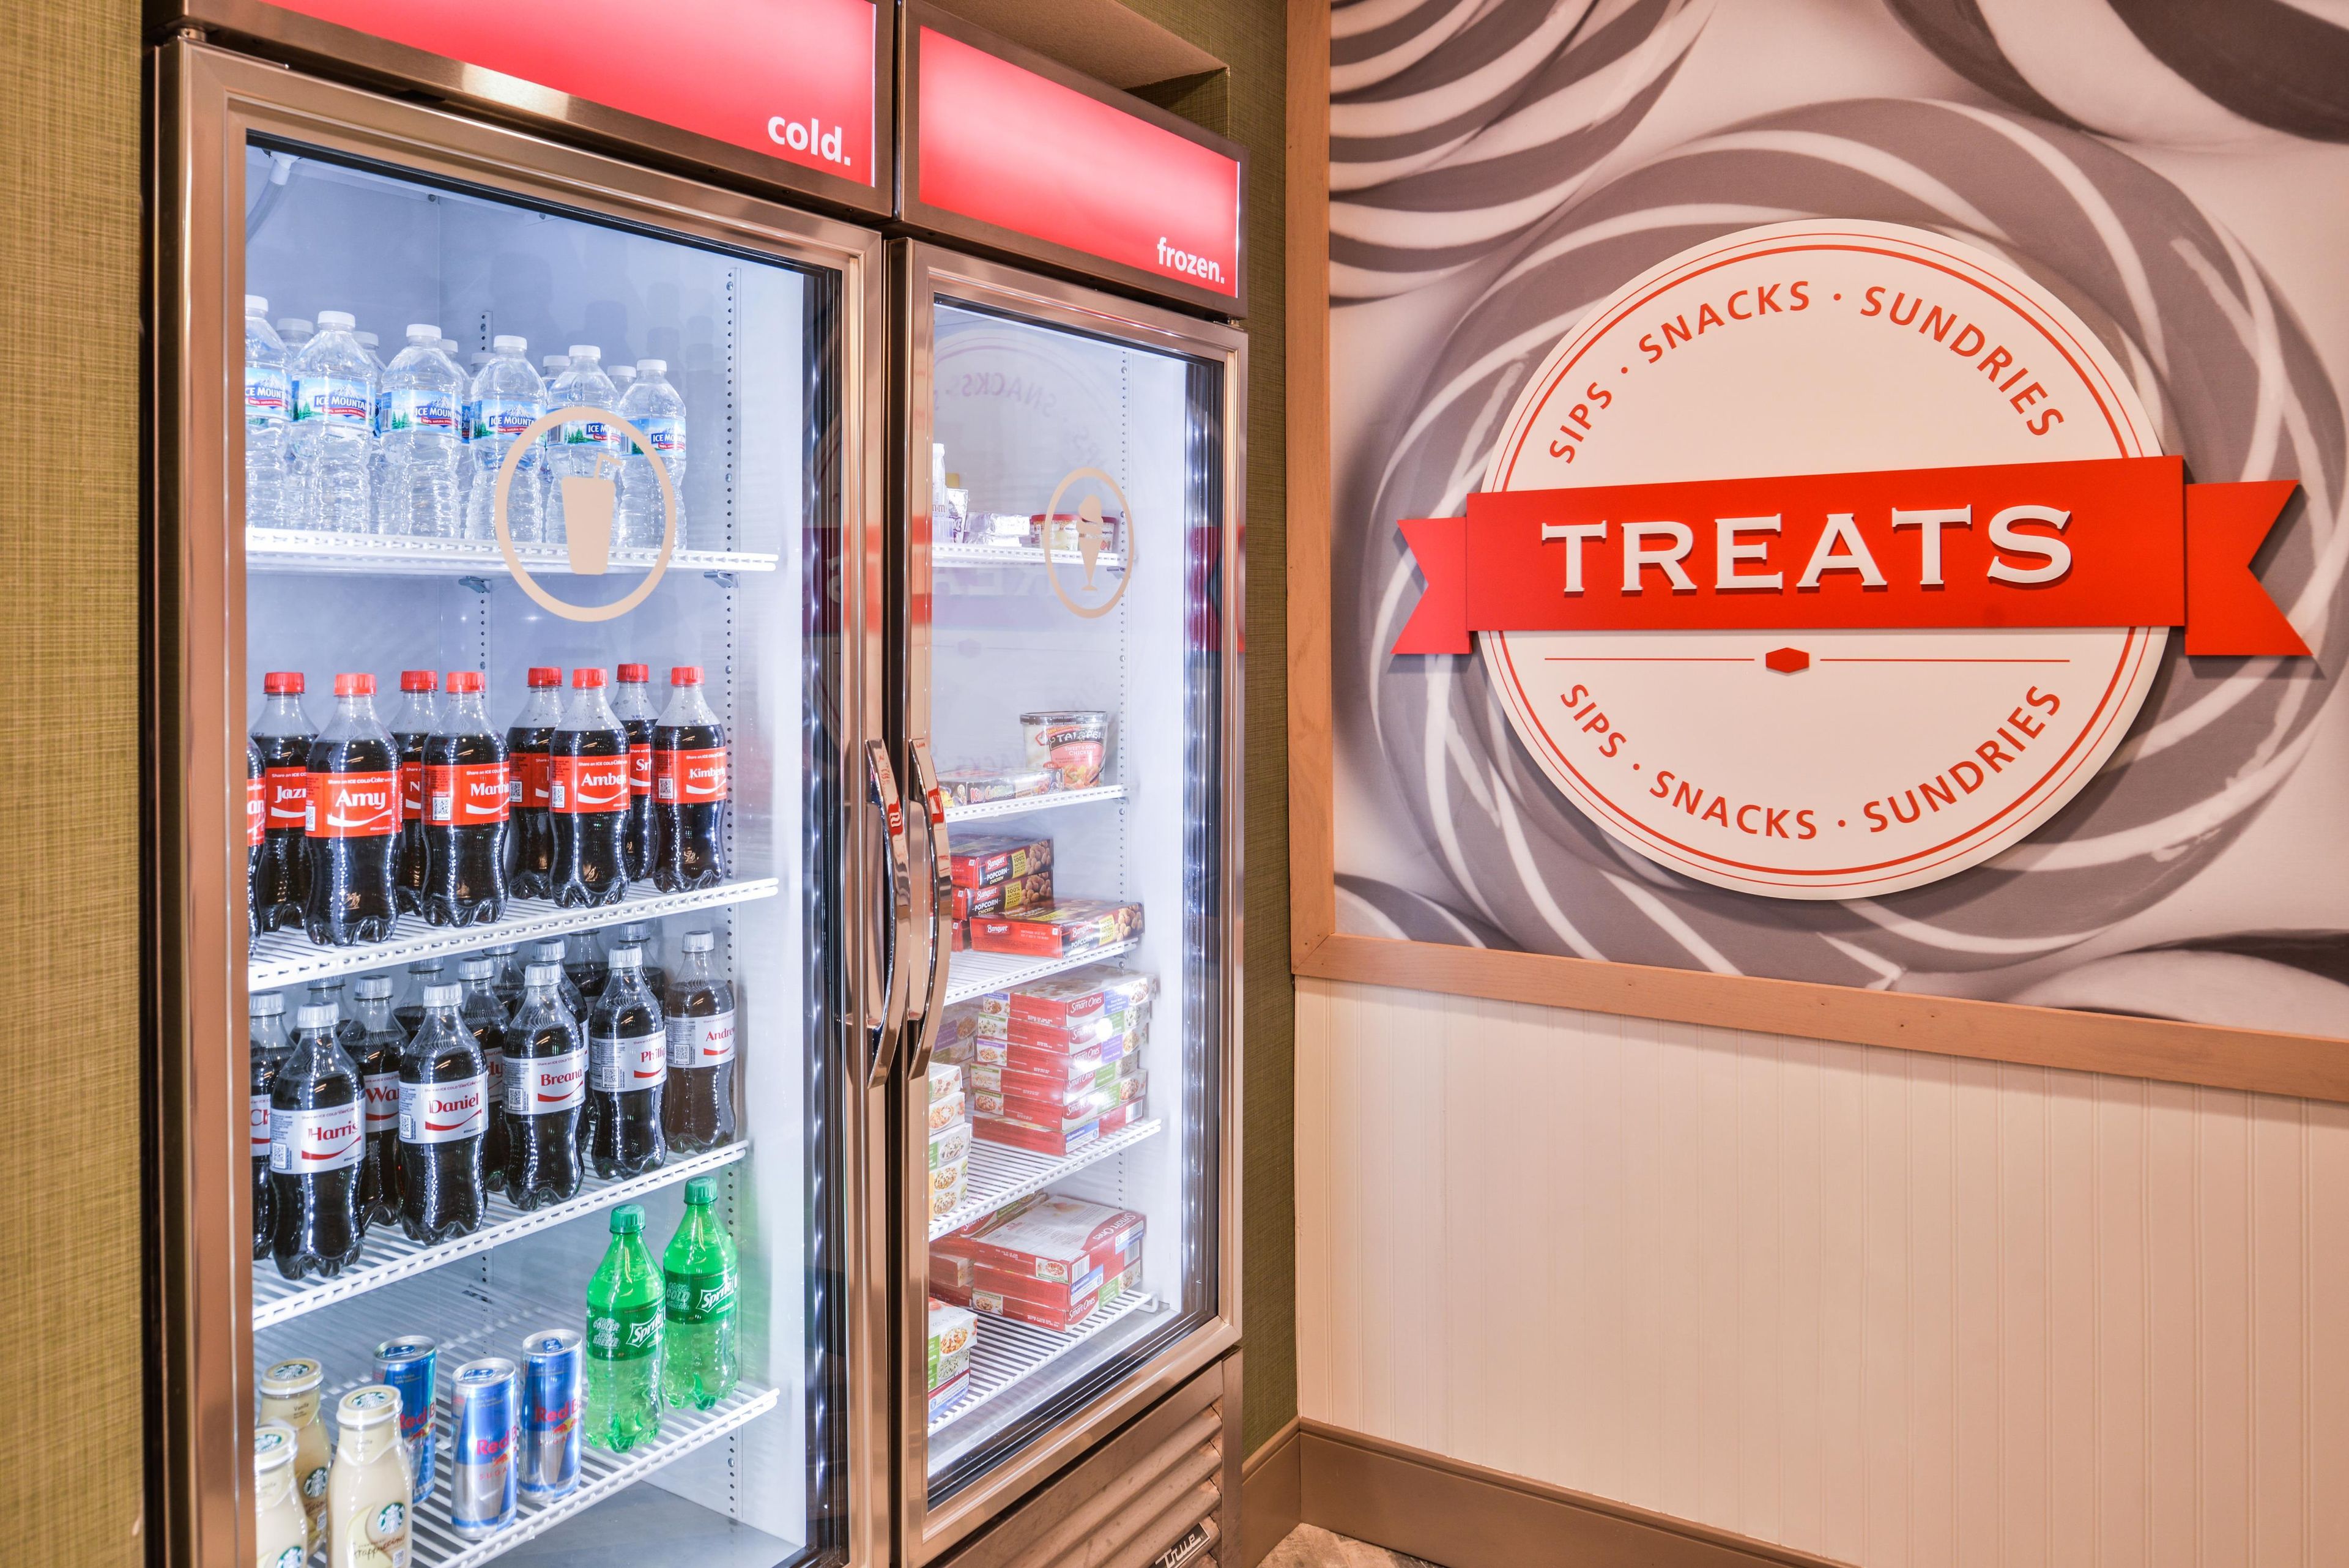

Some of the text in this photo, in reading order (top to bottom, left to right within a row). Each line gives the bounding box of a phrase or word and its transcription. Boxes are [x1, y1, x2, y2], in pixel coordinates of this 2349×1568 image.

[768, 116, 851, 166] cold.
[1157, 236, 1225, 284] frozen.
[1548, 280, 2065, 465] SIPS SNACKS SUNDRIES
[316, 396, 330, 406] ICE
[416, 407, 428, 416] ICE
[491, 417, 502, 425] ICE
[1541, 504, 2072, 593] TREATS
[1057, 732, 1077, 743] TAI
[1560, 683, 2061, 841] SIPS SNACKS SUNDRIES
[335, 788, 386, 809] Amy
[987, 856, 1005, 870] Banquet
[986, 867, 1008, 881] POPCORN
[977, 886, 998, 901] Banquet
[974, 898, 999, 912] POPCORN
[978, 906, 995, 915] CHICKEN
[987, 924, 1009, 933] Banquet
[1070, 1000, 1088, 1014] Smart
[1088, 997, 1102, 1008] Ones
[1088, 1047, 1100, 1058] Ones
[540, 1068, 583, 1087] Breana
[429, 1093, 479, 1114] Daniel
[308, 1120, 358, 1141] Harris
[1093, 1213, 1136, 1241] Smart Ones
[700, 1279, 733, 1309] Sprite
[1068, 1296, 1096, 1321] Smart Ones
[631, 1311, 663, 1345] Sprite
[535, 1400, 570, 1423] Red
[477, 1430, 510, 1455] Red
[1154, 1533, 1202, 1568] True
